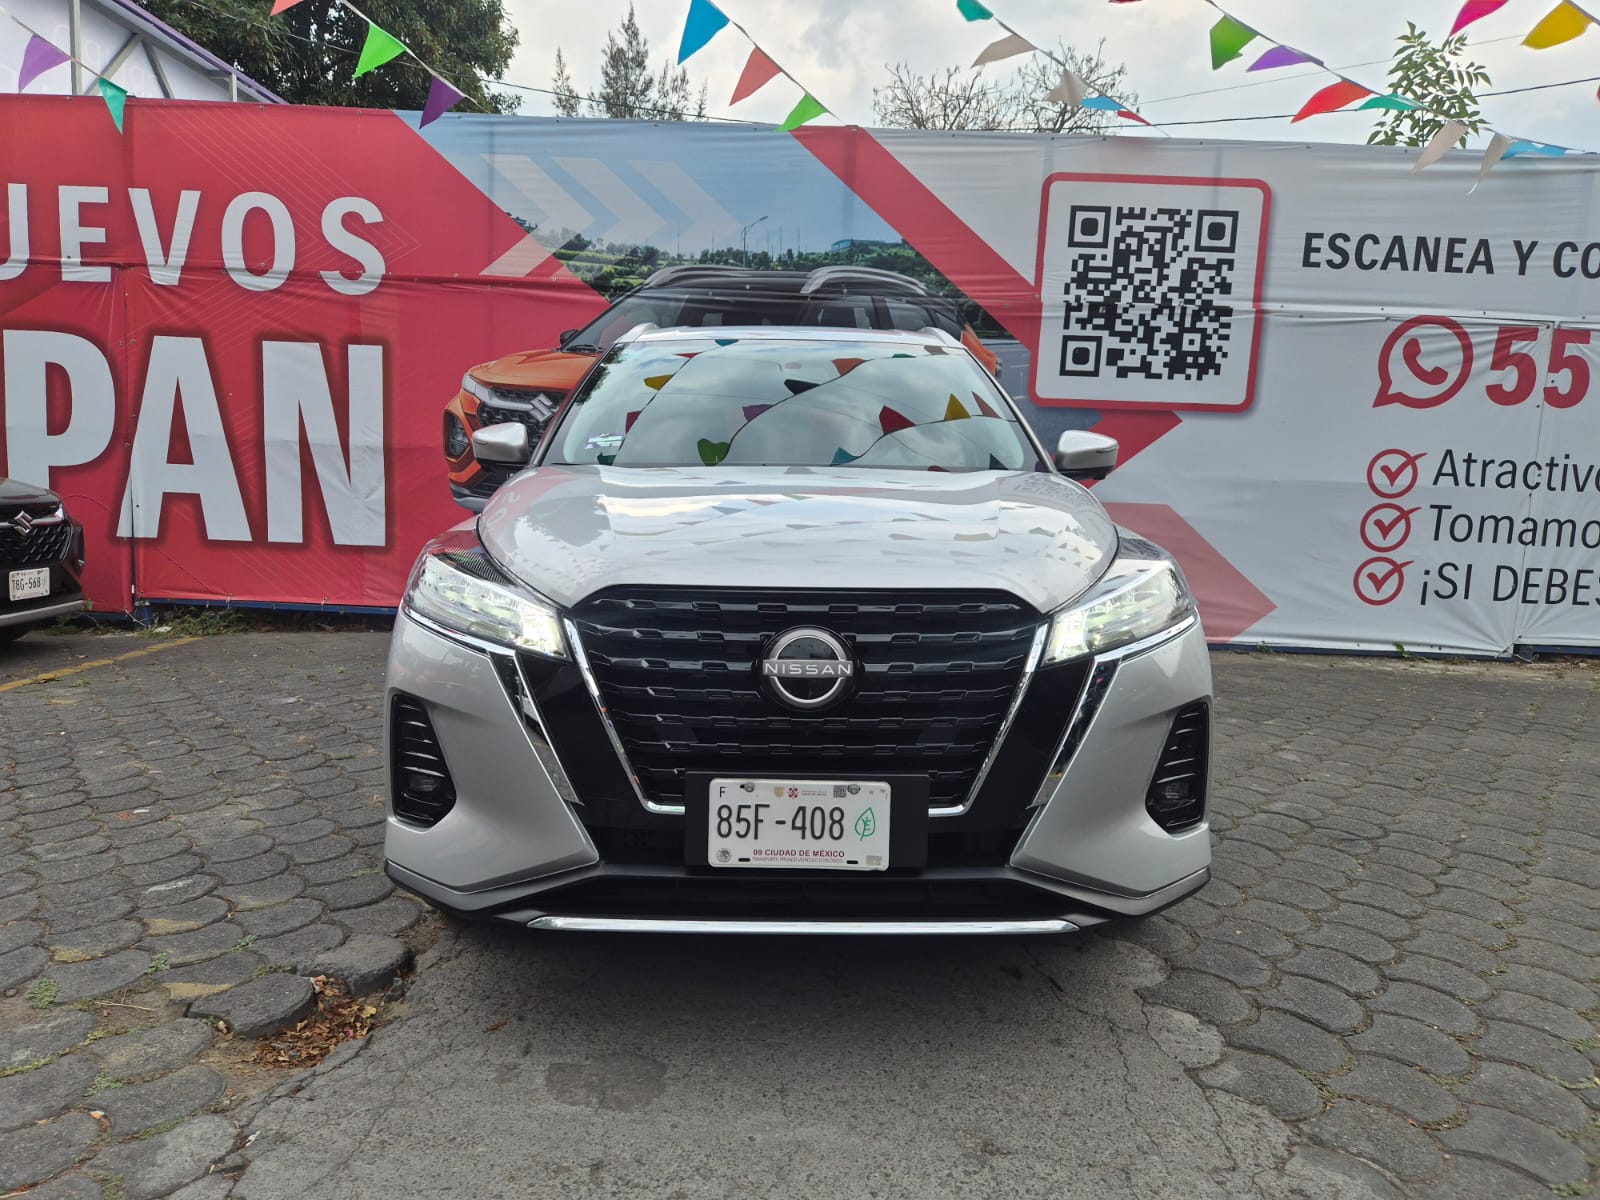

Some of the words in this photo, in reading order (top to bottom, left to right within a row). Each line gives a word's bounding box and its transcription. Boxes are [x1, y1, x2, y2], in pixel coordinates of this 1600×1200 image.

[1302, 232, 1495, 275] ESCANEA
[1513, 240, 1538, 276] Y
[1485, 326, 1591, 408] 55
[3, 329, 386, 547] PAN
[1430, 504, 1600, 549] Tomamo
[1420, 562, 1473, 606] ¡SI
[765, 663, 851, 675] NISSAN
[719, 786, 727, 798] F
[717, 803, 845, 840] 85F-408
[753, 848, 763, 856] 09
[764, 849, 797, 857] CIUDAD
